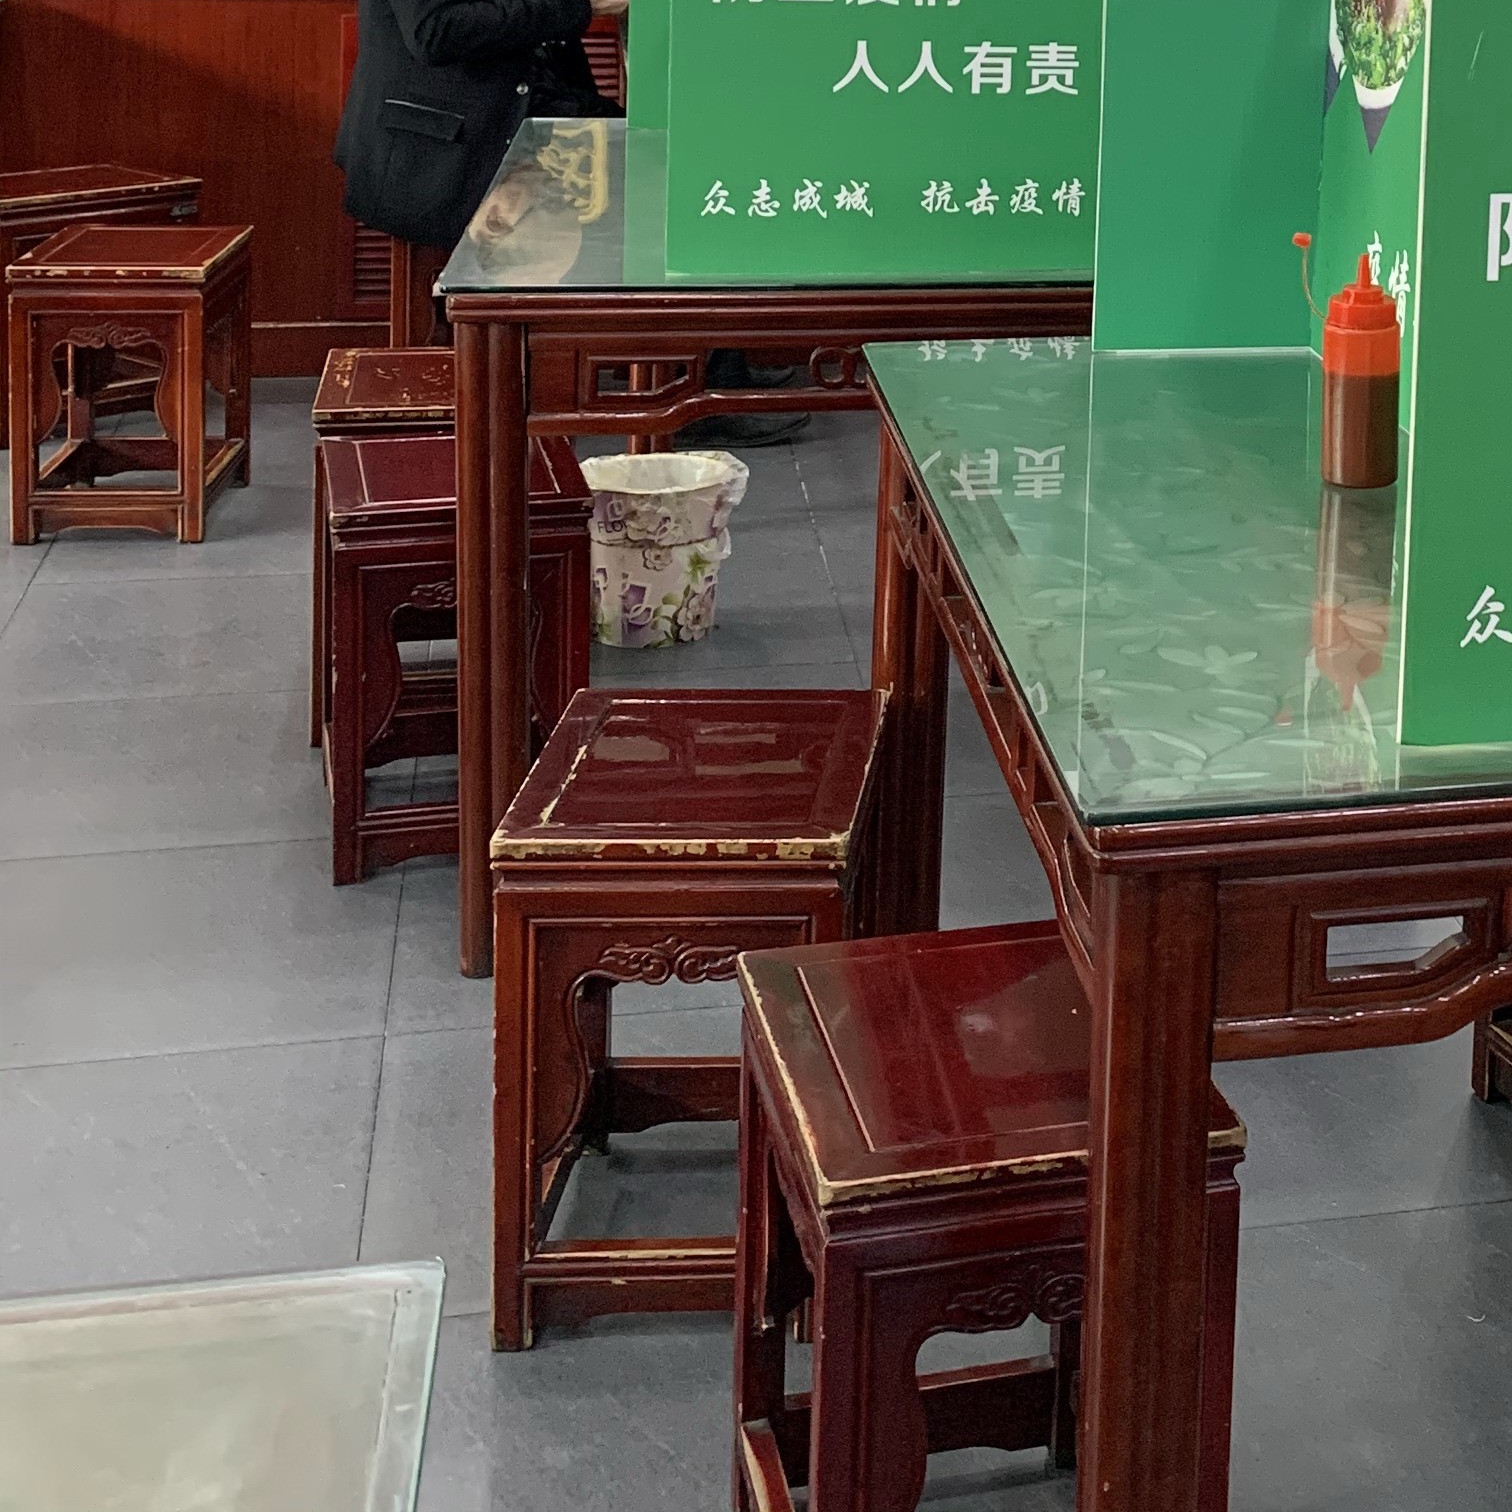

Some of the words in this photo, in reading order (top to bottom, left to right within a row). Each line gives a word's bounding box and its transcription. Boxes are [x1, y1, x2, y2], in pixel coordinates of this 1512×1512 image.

[832, 39, 1080, 96] 人人有责
[700, 178, 874, 219] 众志成城
[920, 178, 1087, 218] 抗击疫情
